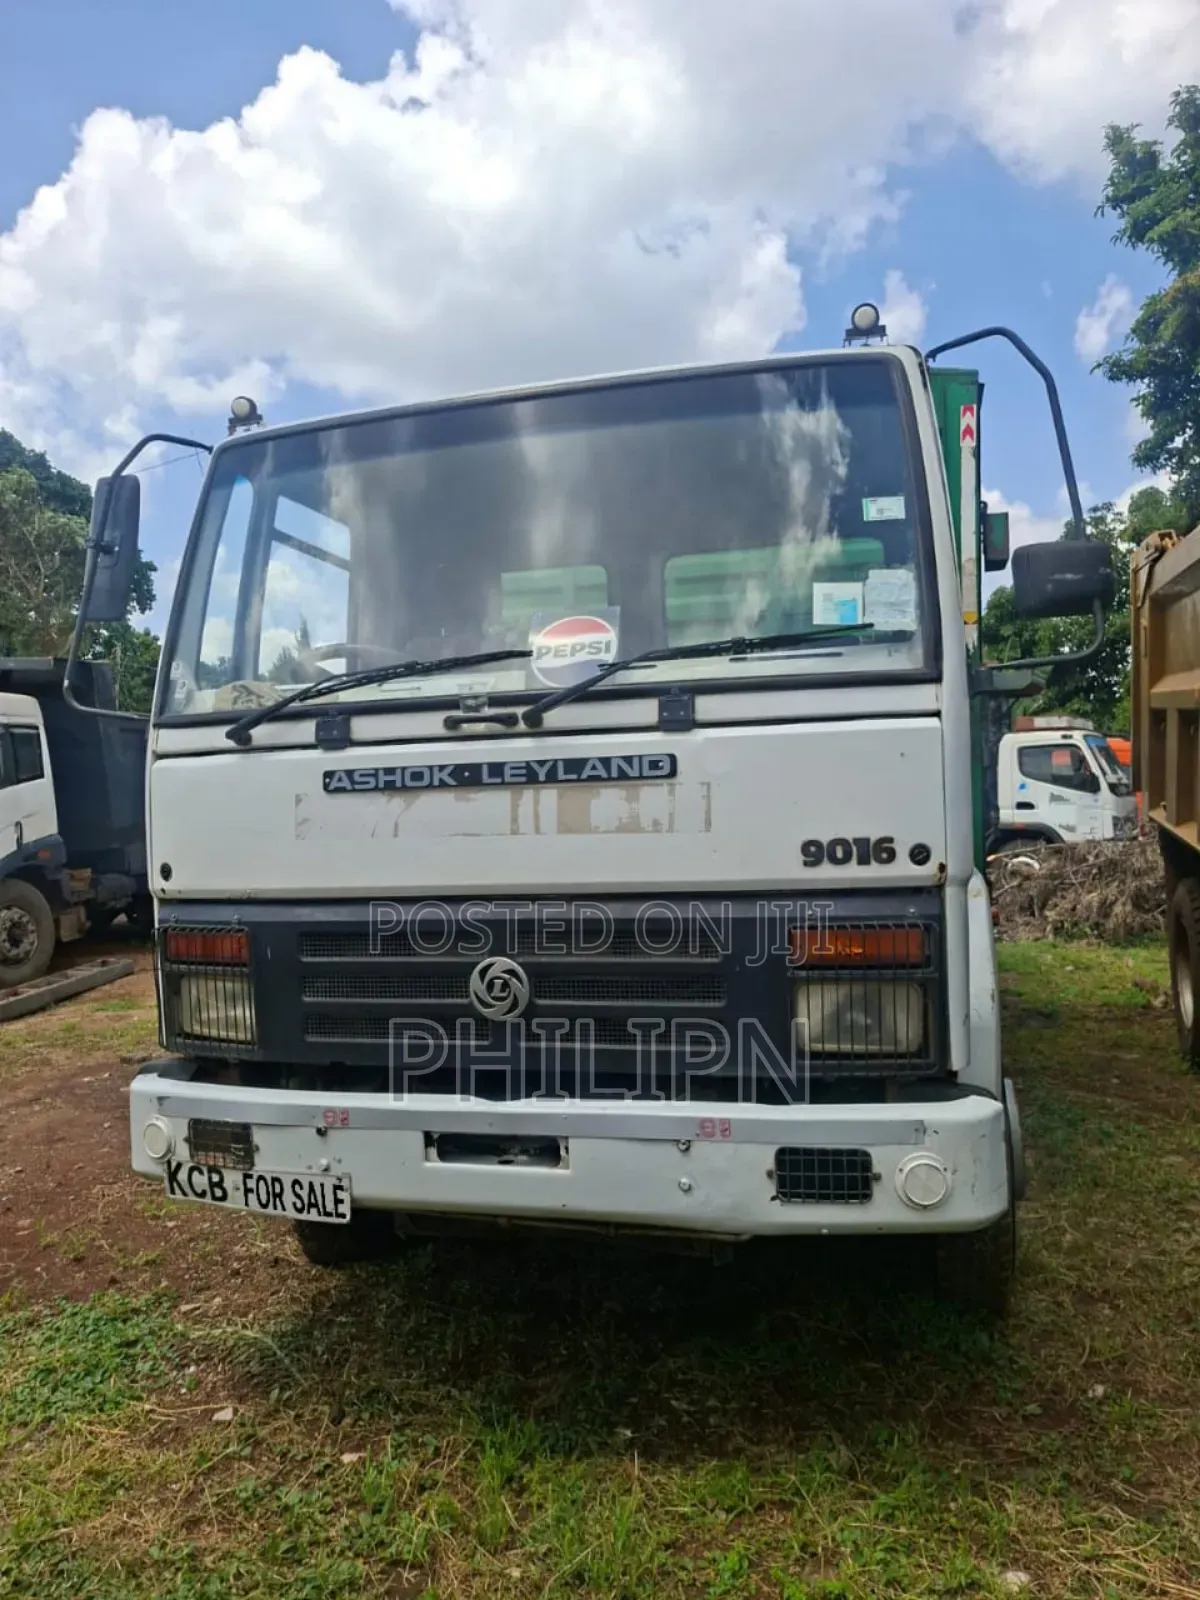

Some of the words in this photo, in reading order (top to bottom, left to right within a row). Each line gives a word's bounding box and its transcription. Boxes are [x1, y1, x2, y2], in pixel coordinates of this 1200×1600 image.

[536, 639, 611, 661] PEPSI
[327, 767, 457, 791] ASHOK
[482, 754, 671, 784] LEYLAND
[801, 836, 896, 867] 9016
[490, 979, 510, 997] L
[166, 1160, 228, 1202] KCB
[242, 1172, 287, 1212] FOR
[291, 1178, 347, 1219] SALE
